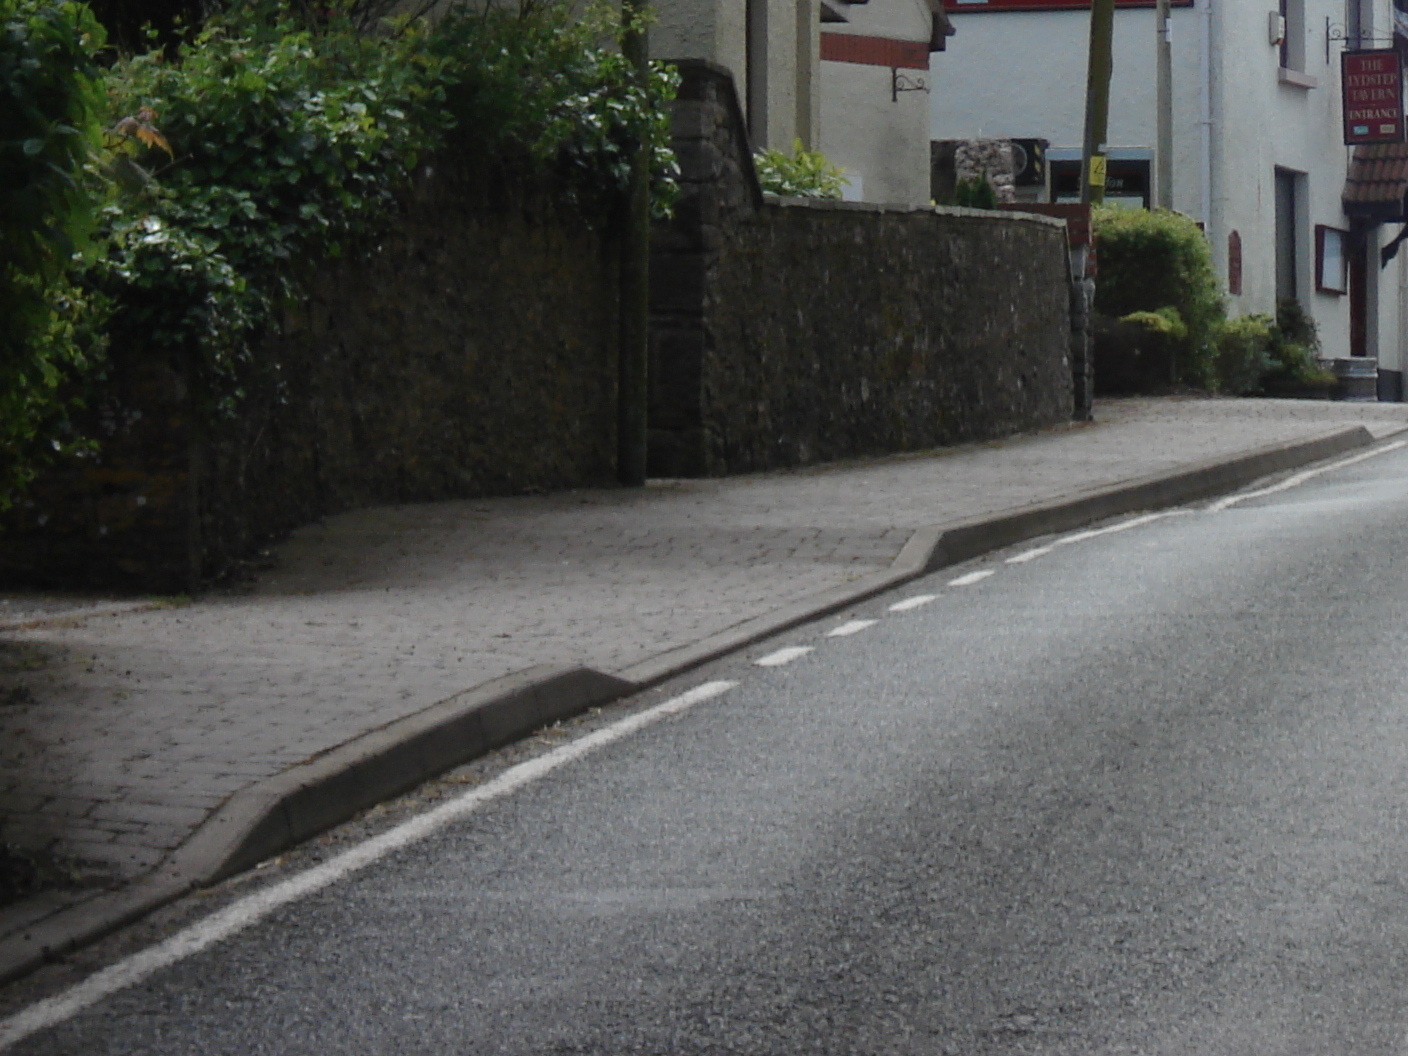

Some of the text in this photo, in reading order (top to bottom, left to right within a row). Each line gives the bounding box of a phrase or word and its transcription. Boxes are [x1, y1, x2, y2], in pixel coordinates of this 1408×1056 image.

[1361, 59, 1384, 71] THE
[1348, 73, 1397, 86] LYDSTEP
[1352, 88, 1396, 101] TAVERN
[1349, 108, 1398, 120] ENTRANCE
